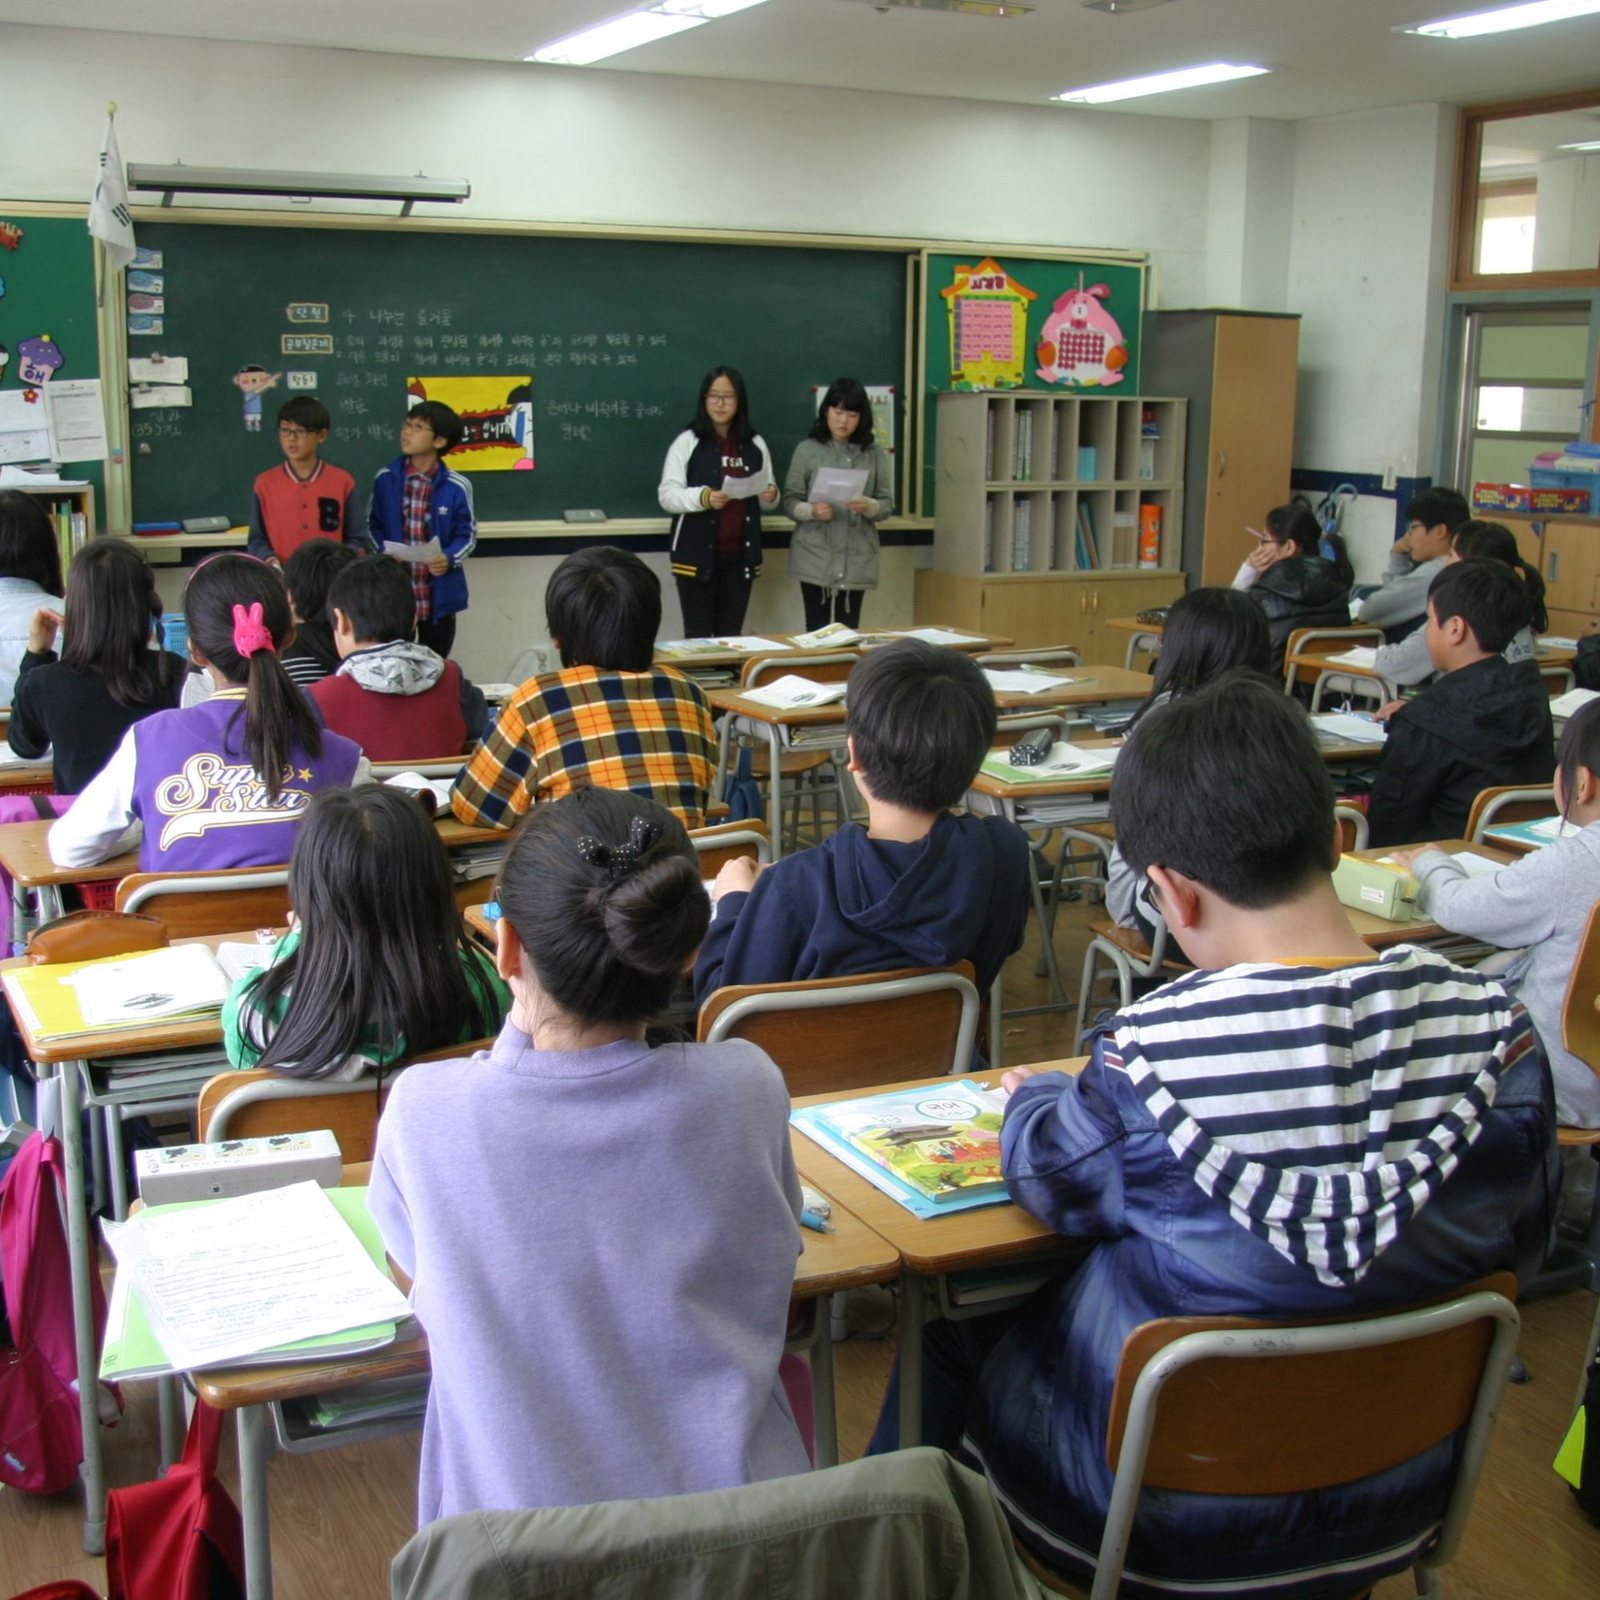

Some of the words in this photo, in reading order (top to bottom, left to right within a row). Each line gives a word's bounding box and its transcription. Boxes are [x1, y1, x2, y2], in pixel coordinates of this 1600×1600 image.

[25, 364, 45, 383] 해
[319, 497, 341, 532] B
[156, 753, 294, 815] Sup
